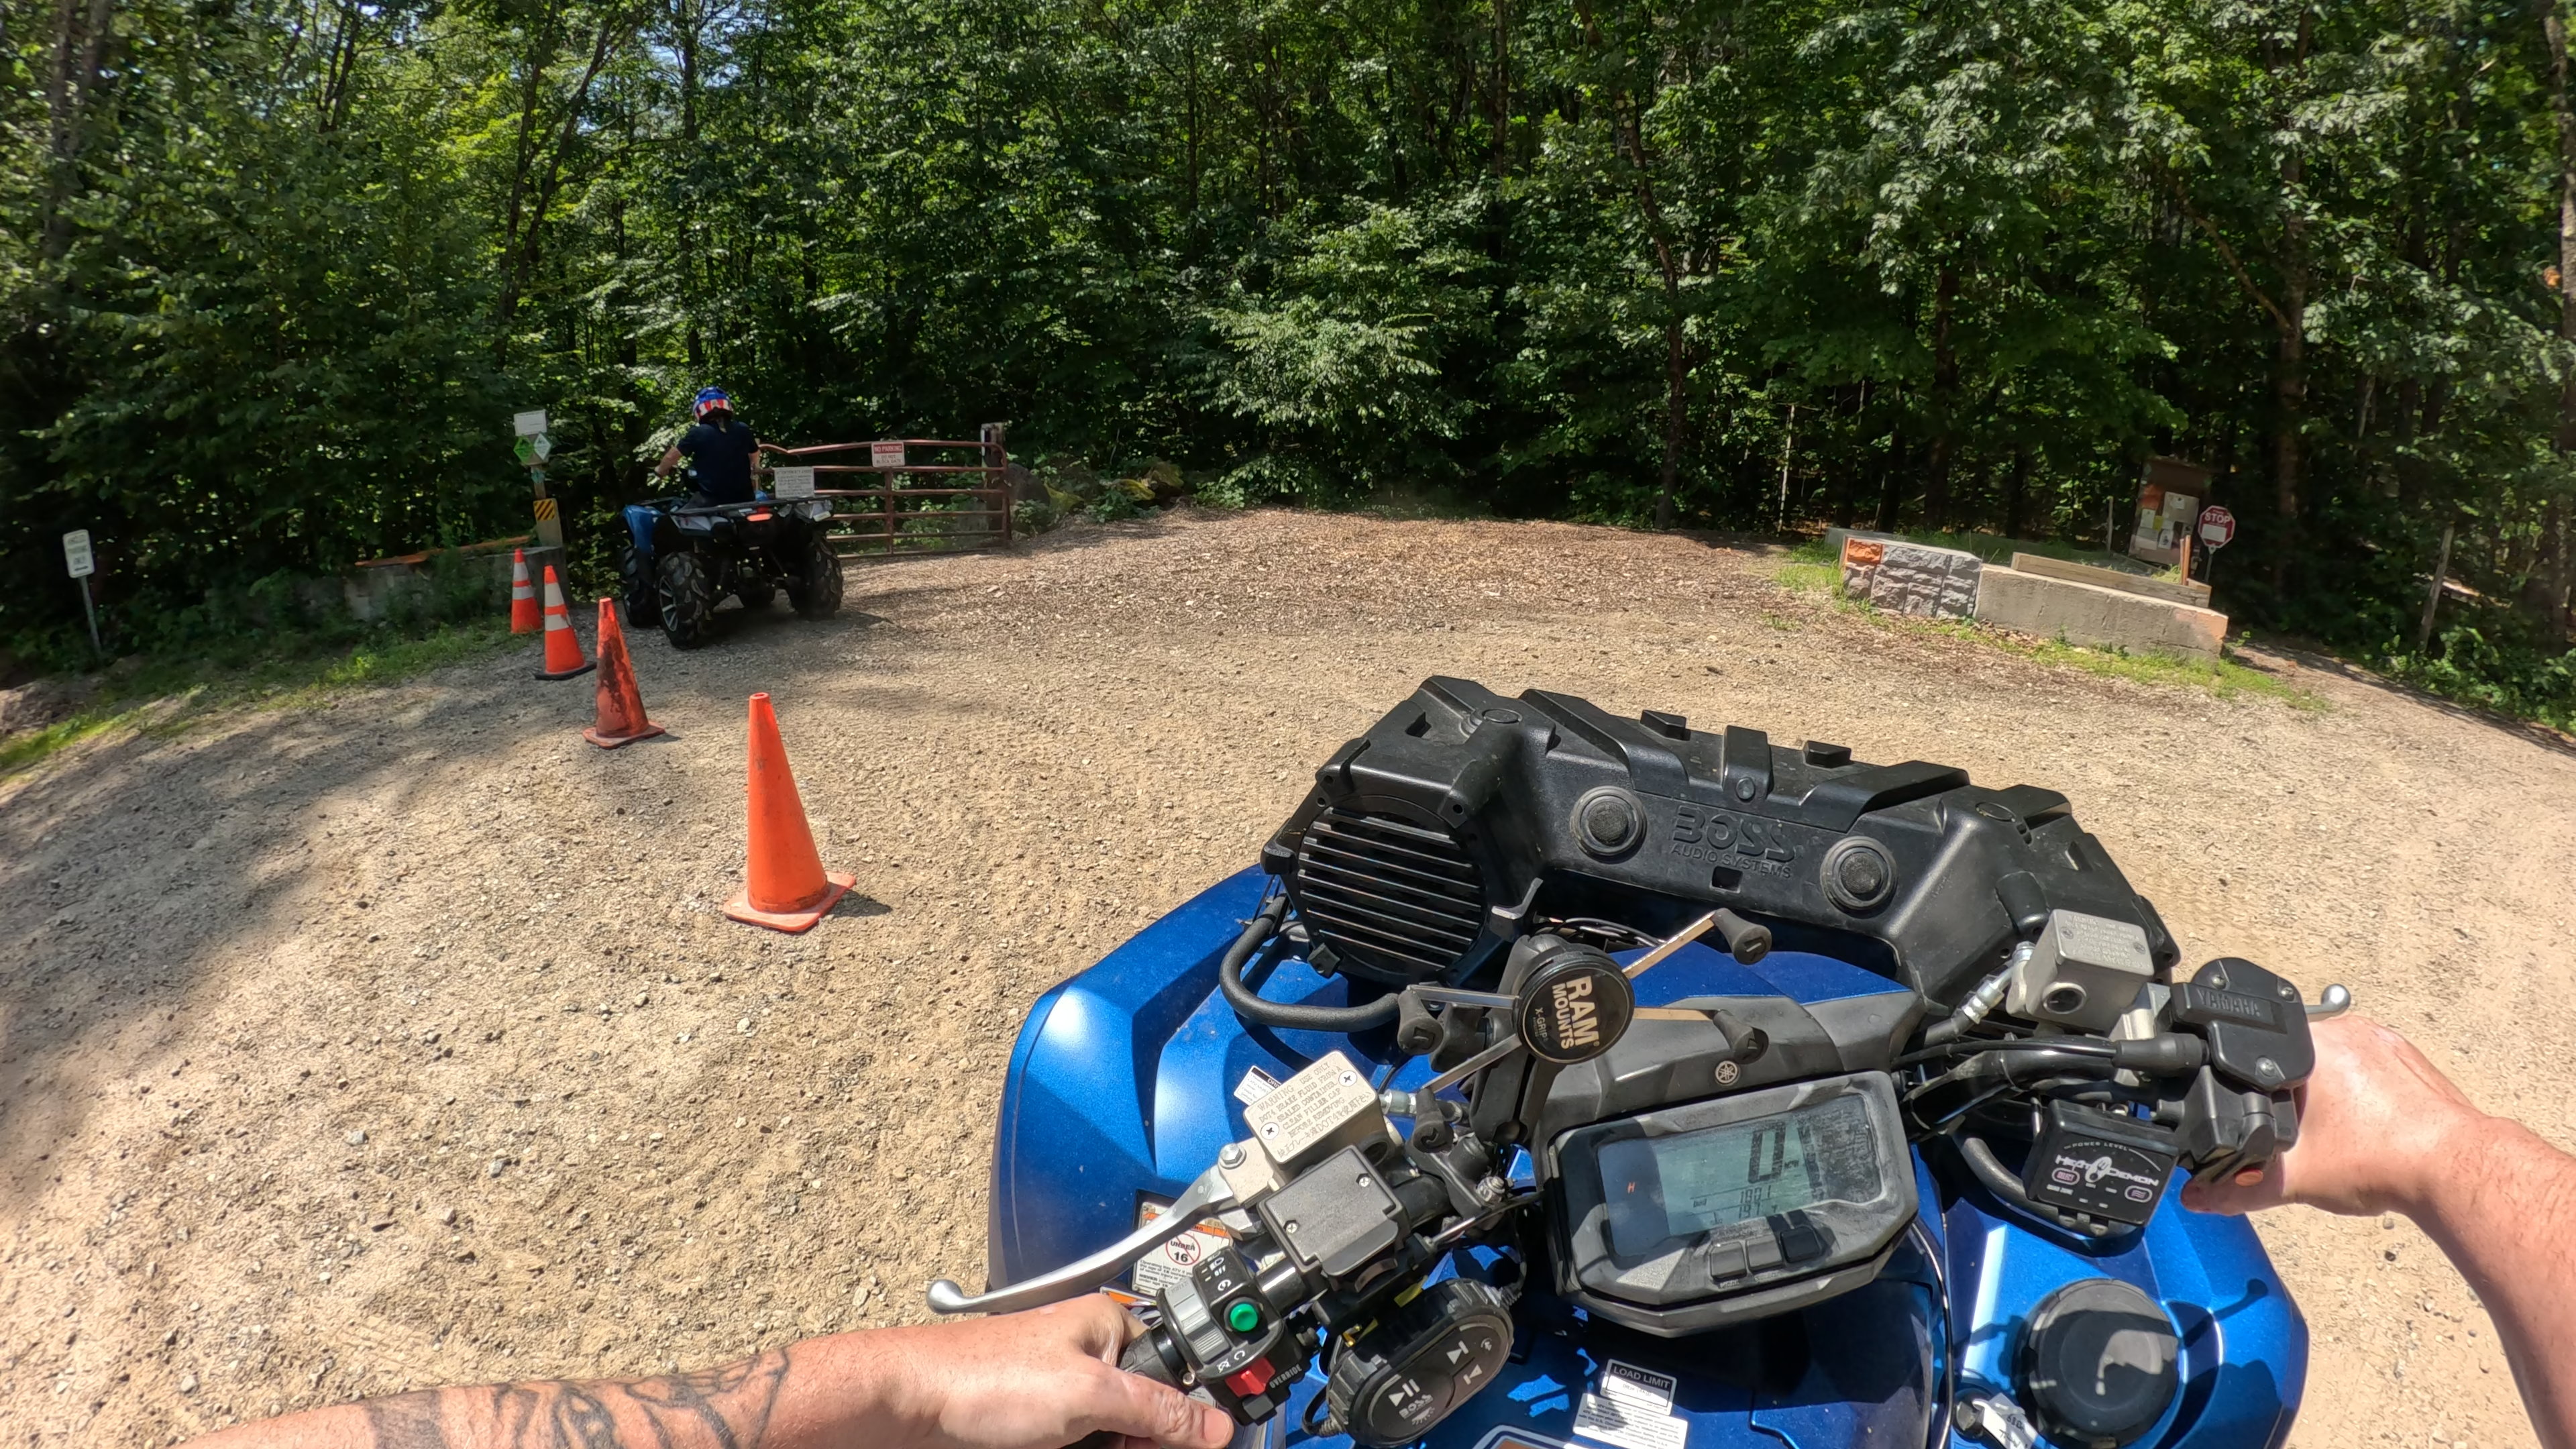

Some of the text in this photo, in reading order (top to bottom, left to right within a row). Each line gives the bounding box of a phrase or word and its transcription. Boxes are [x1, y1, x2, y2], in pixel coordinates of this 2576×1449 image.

[2204, 512, 2231, 524] STOP
[1673, 805, 1796, 863] BOSS
[1671, 845, 1792, 879] AUDIO SYSTEMS
[1552, 983, 1574, 1050] MOUNTS
[1566, 975, 1600, 1046] RAM
[2196, 987, 2261, 1018] YAMAHA
[1535, 1007, 1548, 1039] X-GRIP
[1257, 1085, 1295, 1112] WARNING
[1299, 1073, 1313, 1085] USE
[1313, 1062, 1330, 1076] ONLY
[1276, 1094, 1298, 1112] BRAKE
[1297, 1081, 1318, 1097] FLUID
[1318, 1069, 1338, 1084] FROM
[1277, 1081, 1339, 1122] SEALED CONTAINER
[1282, 1087, 1341, 1130] CLEAN FILLER CAP
[1288, 1097, 1346, 1138] BEFORE REMOVING
[1748, 1119, 1787, 1184] 0
[2104, 1142, 2128, 1152] LEVEL
[1627, 1181, 1635, 1194] H
[1170, 1240, 1195, 1252] UNDER
[1173, 1251, 1189, 1263] 16
[1269, 1363, 1303, 1389] OVERRIDE
[1613, 1366, 1670, 1389] LOAD LIMIT
[1399, 1394, 1434, 1419] BOSS
